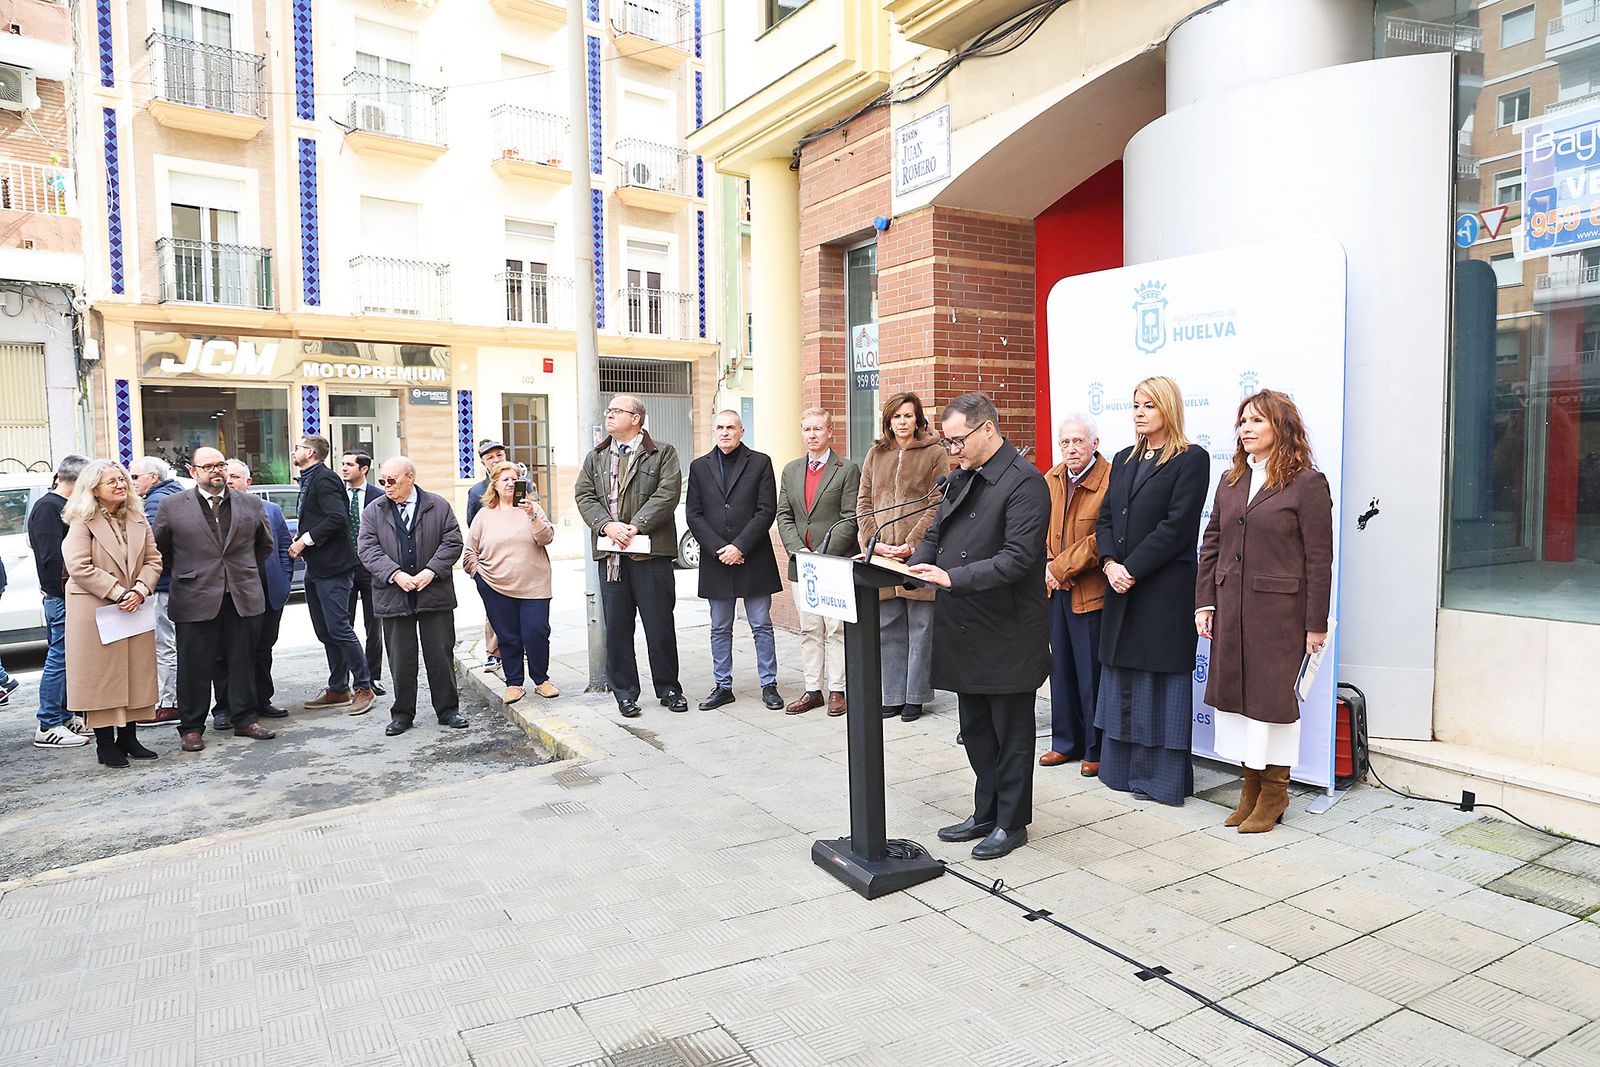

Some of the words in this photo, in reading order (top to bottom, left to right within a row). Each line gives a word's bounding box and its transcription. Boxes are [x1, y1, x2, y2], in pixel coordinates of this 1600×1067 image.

[902, 141, 923, 165] JUAN
[902, 155, 937, 186] ROMERO
[1531, 205, 1581, 238] 959
[1173, 310, 1226, 322] Ayuntamiento
[1173, 320, 1237, 342] HUELVA
[160, 338, 279, 375] JCM
[303, 363, 446, 382] MOTOPREMIUM
[521, 375, 535, 385] 102
[857, 375, 868, 387] 959
[1105, 402, 1133, 411] HUELVA
[1184, 398, 1210, 407] UELVA
[1212, 452, 1233, 460] HUELV
[821, 595, 847, 609] HUELVA
